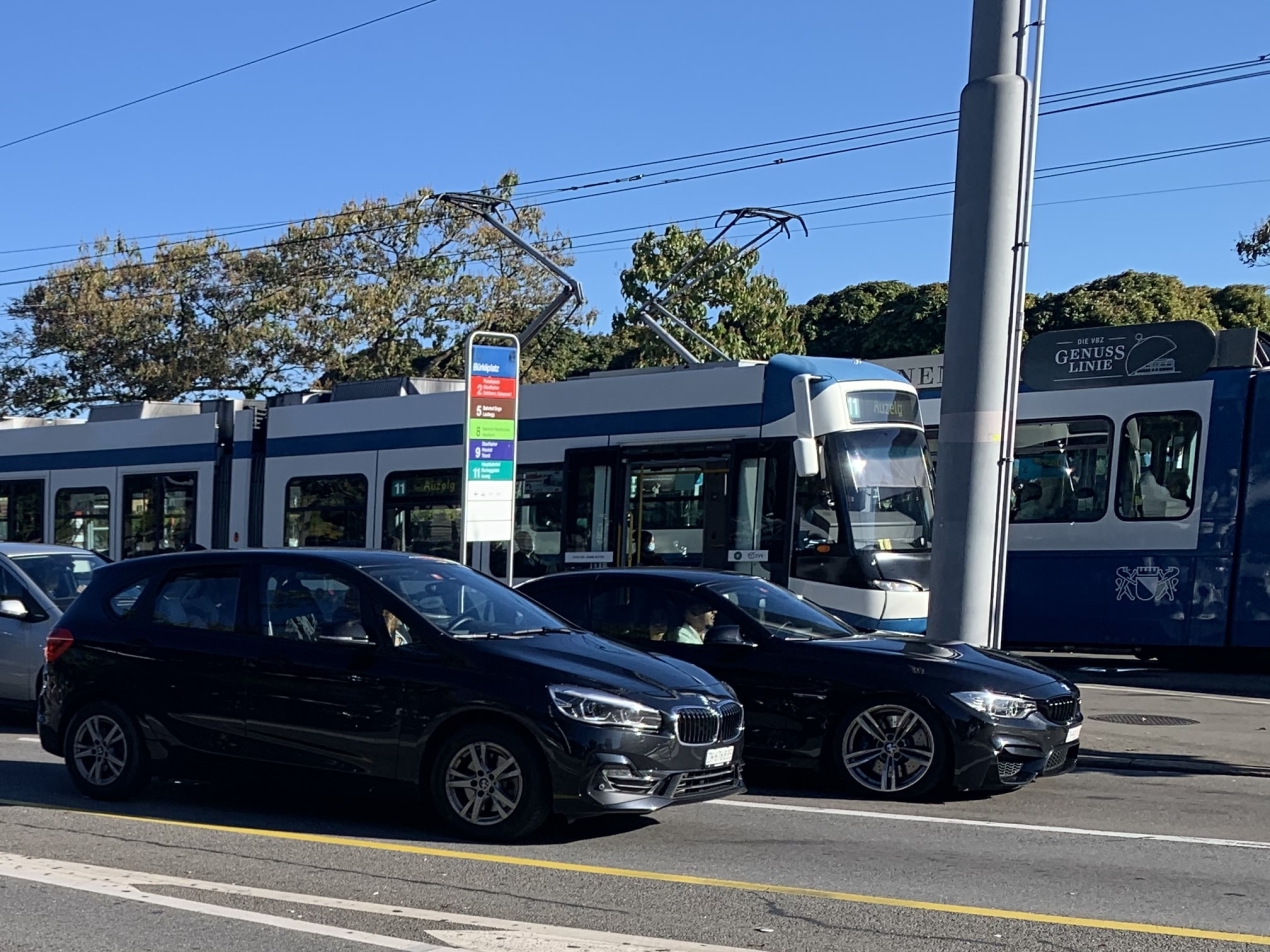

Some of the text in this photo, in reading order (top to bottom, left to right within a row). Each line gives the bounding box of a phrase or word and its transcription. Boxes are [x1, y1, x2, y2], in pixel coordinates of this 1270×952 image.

[1055, 345, 1125, 364] GENUSS
[1068, 359, 1113, 373] LINIE
[476, 384, 483, 396] 2
[476, 405, 482, 417] 5
[873, 401, 903, 417] Auzelg
[476, 426, 481, 437] 8
[475, 446, 481, 459] 9
[472, 467, 481, 479] 11
[394, 482, 406, 495] 11
